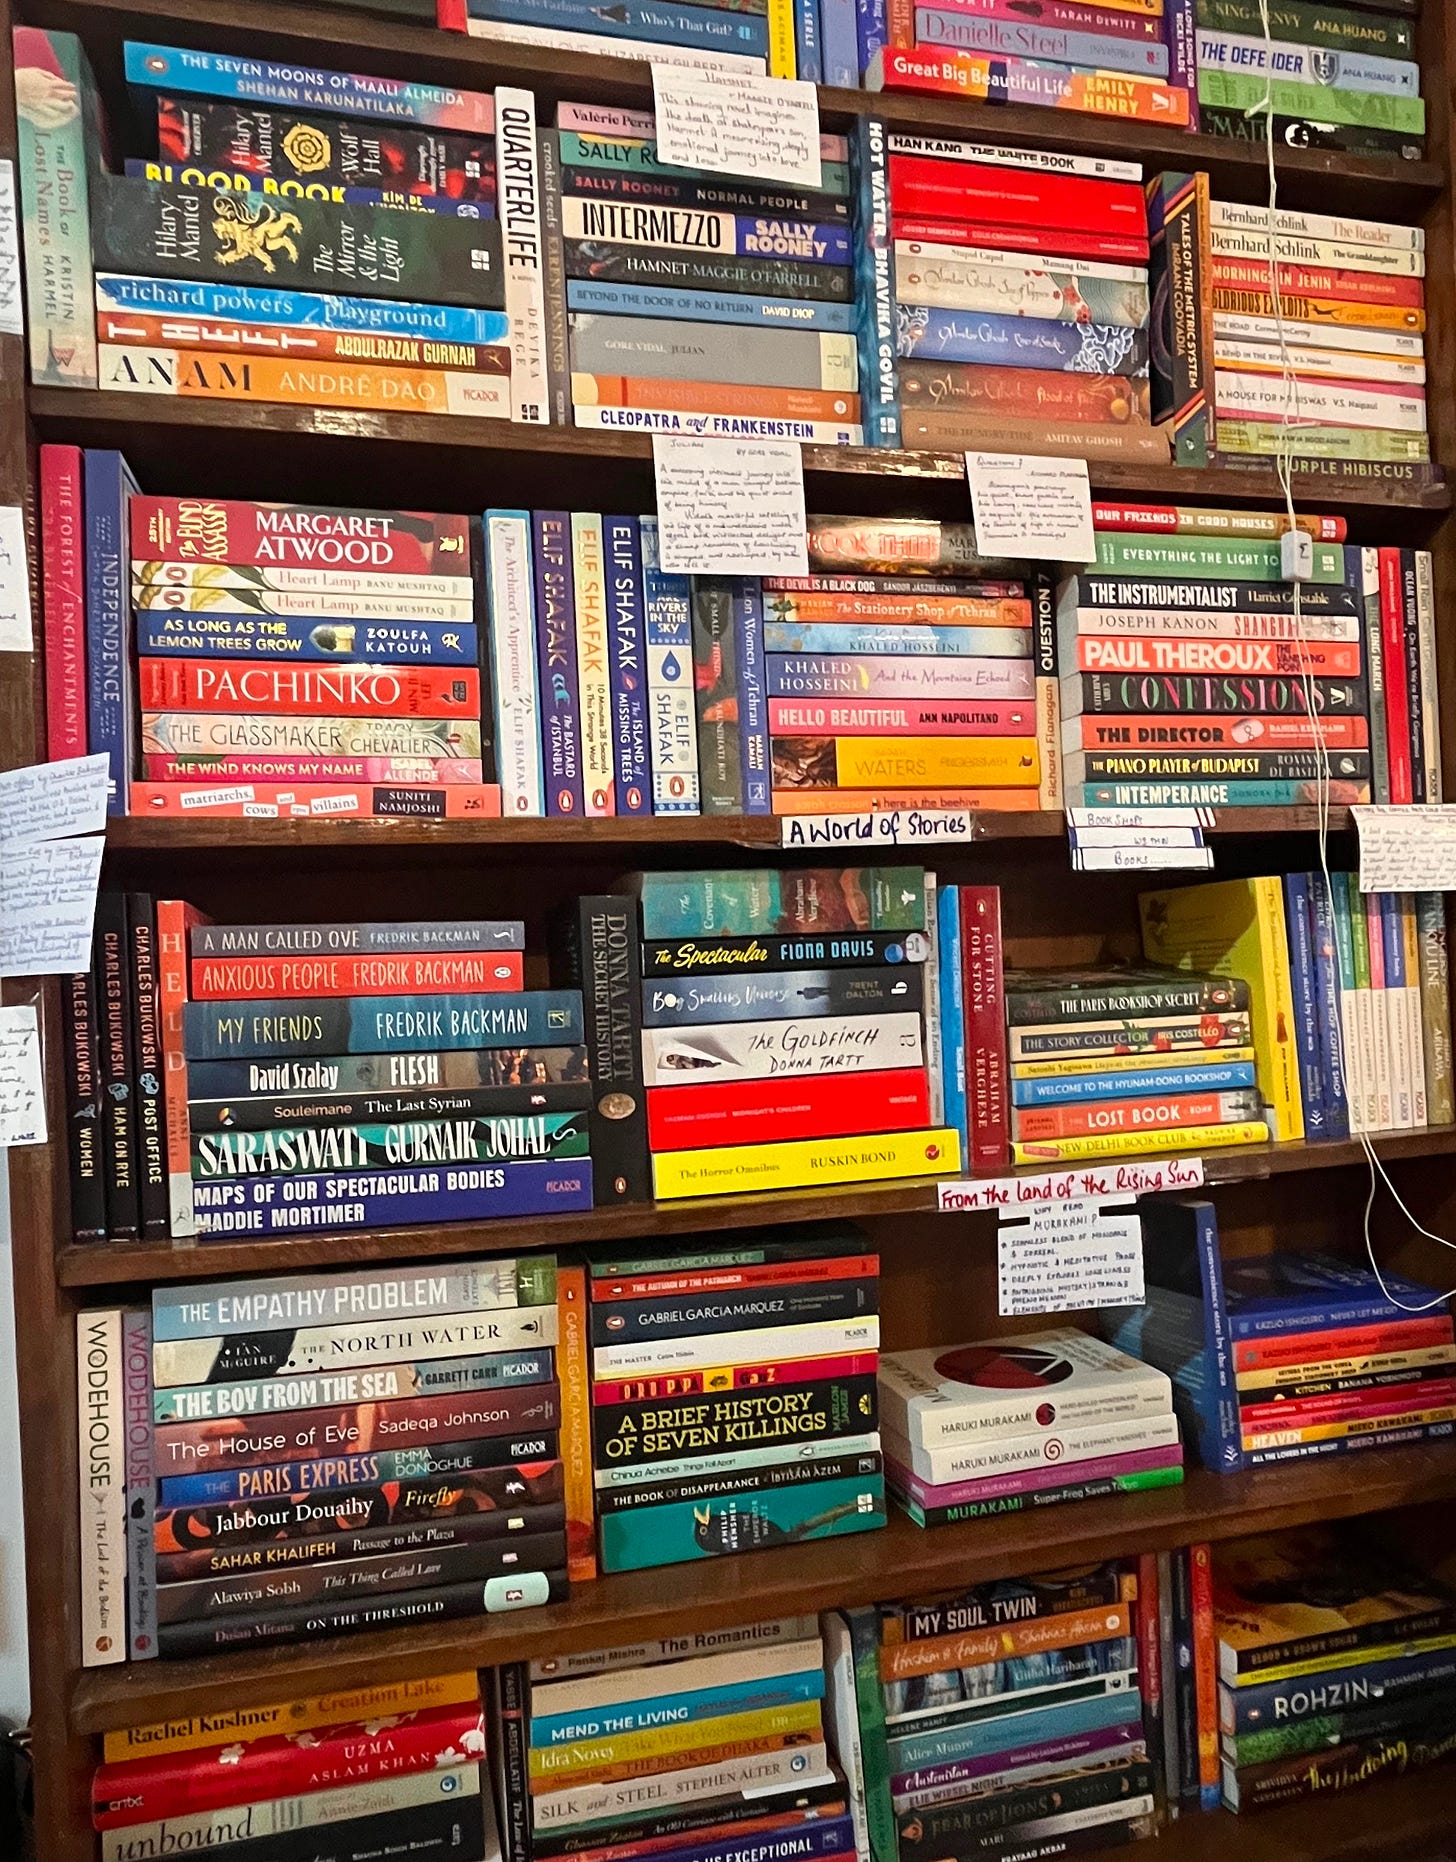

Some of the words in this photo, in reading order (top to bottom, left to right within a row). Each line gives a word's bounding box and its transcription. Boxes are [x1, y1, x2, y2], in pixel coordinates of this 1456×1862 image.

[640, 11, 674, 26] Who's
[677, 15, 703, 30] That
[707, 22, 733, 36] Girl?
[1314, 20, 1340, 36] ANA
[1343, 24, 1386, 42] HUANG
[181, 55, 209, 69] THE
[215, 59, 262, 76] SEVEN
[268, 66, 324, 84] MOONS
[329, 73, 349, 88] OF
[354, 77, 399, 95] MAALI
[404, 83, 465, 106] ALMEIDA
[893, 56, 939, 77] Great
[942, 63, 968, 84] Big
[971, 67, 1040, 93] Beautiful
[1044, 78, 1073, 96] Life
[1086, 78, 1135, 98] EMILY
[237, 80, 298, 100] SHEHAN
[304, 88, 415, 117] KARUNATILAKA
[1085, 94, 1139, 115] HENRY
[867, 122, 885, 163] HOT
[501, 107, 538, 269] QUARTERLIFE
[696, 189, 754, 205] NORMAL
[760, 196, 809, 211] PEOPLE
[869, 169, 889, 237] WATER
[581, 202, 722, 248] INTERMEZZO
[754, 220, 816, 241] SALLY
[1181, 213, 1191, 248] TALES
[746, 234, 827, 259] ROONEY
[1182, 250, 1192, 269] OF
[627, 258, 689, 276] HAMNET
[693, 263, 747, 283] MAGGIE
[751, 268, 820, 288] O'FARRELL
[1183, 269, 1193, 295] THE
[118, 282, 206, 306] richard
[213, 293, 294, 316] powers
[324, 304, 447, 330] playground
[577, 289, 618, 303] BEYOND
[621, 291, 642, 304] THE
[643, 294, 675, 307] DOOR
[678, 296, 693, 308] OF
[695, 298, 711, 310] NO
[714, 299, 754, 314] RETURN
[761, 305, 790, 317] DAVID
[791, 307, 815, 319] DIOP
[874, 248, 890, 339] BHAVIKA
[1185, 296, 1196, 340] METRIC
[334, 336, 419, 362] ABDULRAZAK
[424, 342, 476, 365] GURNAH
[1187, 341, 1198, 389] SYSTEM
[878, 344, 894, 403] GOVIL
[600, 409, 680, 429] CLEOPATRA
[686, 414, 708, 432] and
[713, 417, 814, 438] FRANKENSTEIN
[1046, 433, 1081, 445] AMITAV
[1085, 435, 1122, 448] GHOSH
[255, 511, 394, 538] MARGARET
[255, 537, 394, 565] ATWOOD
[611, 527, 632, 569] ELIF
[277, 570, 318, 587] Heart
[323, 573, 361, 591] Lamp
[367, 580, 393, 591] BANU
[396, 582, 446, 592] MUSHTAQ
[1090, 582, 1114, 604] THE
[1117, 583, 1238, 607] INSTRUMENTALIST
[367, 628, 429, 642] ZOULFA
[615, 577, 637, 670] SHAFAK
[1099, 614, 1155, 629] JOSEPH
[1161, 616, 1218, 630] KANON
[366, 642, 431, 655] KATOUH
[1085, 639, 1149, 667] PAUL
[1153, 641, 1273, 669] THEROUX
[196, 669, 400, 705] PACHINKO
[779, 708, 825, 725] HELLO
[830, 710, 909, 727] BEAUTIFUL
[169, 724, 201, 744] THE
[210, 725, 340, 747] GLASSMAKER
[790, 820, 806, 843] A
[810, 813, 872, 841] World
[880, 815, 899, 843] of
[908, 811, 966, 837] Stories
[655, 950, 671, 962] The
[674, 942, 768, 967] Spectacular
[781, 942, 824, 960] FIONA
[831, 940, 874, 958] DAVIS
[202, 965, 276, 992] ANXIOUS
[281, 963, 339, 990] PEOPLE
[353, 962, 410, 987] FREDRIK
[415, 960, 484, 985] BACKMAN
[749, 1033, 773, 1051] The
[249, 1065, 288, 1092] David
[293, 1064, 339, 1091] Szalay
[390, 1057, 439, 1086] FLESH
[274, 1103, 352, 1119] Souleimane
[365, 1100, 391, 1113] The
[396, 1100, 424, 1112] Last
[428, 1097, 471, 1111] Syrian
[198, 1128, 369, 1176] SARASWATI
[385, 1124, 479, 1163] GURNAIK
[486, 1117, 552, 1157] JOHAL
[810, 1154, 856, 1168] RUSKIN
[860, 1151, 896, 1163] BOND
[942, 1190, 980, 1209] From
[985, 1187, 1013, 1205] the
[1017, 1180, 1052, 1202] land
[1056, 1177, 1073, 1198] of
[1081, 1175, 1109, 1196] the
[1116, 1167, 1164, 1194] Rising
[1169, 1160, 1199, 1183] Sun
[194, 1211, 264, 1233] MADDIE
[270, 1204, 365, 1227] MORTIMER
[181, 1303, 210, 1323] THE
[218, 1289, 328, 1321] EMPATHY
[335, 1278, 447, 1312] PROBLEM
[88, 1321, 111, 1488] WODEHOUSE
[173, 1391, 213, 1418] THE
[218, 1386, 258, 1412] BOY
[262, 1380, 316, 1407] FROM
[321, 1376, 358, 1401] THE
[363, 1372, 398, 1397] SEA
[619, 1413, 636, 1433] A
[640, 1404, 708, 1430] BRIEF
[715, 1393, 814, 1421] HISTORY
[941, 1418, 979, 1433] HARUKI
[981, 1411, 1032, 1429] MURAKAMI
[168, 1441, 210, 1460] The
[220, 1432, 285, 1453] House
[296, 1428, 314, 1447] of
[325, 1425, 359, 1444] Eve
[379, 1416, 438, 1437] Sadeqa
[444, 1407, 509, 1425] Johnson
[605, 1437, 636, 1458] OF
[643, 1427, 719, 1453] SEVEN
[725, 1412, 827, 1443] KILLINGS
[216, 1509, 287, 1535] Jabbour
[296, 1498, 373, 1527] Douaihy
[405, 1488, 456, 1507] Firefly
[947, 1498, 1023, 1521] MURAKAMI
[915, 1616, 942, 1635] MY
[947, 1605, 989, 1630] SOUL
[994, 1597, 1037, 1620] TWIN
[658, 1638, 688, 1655] The
[695, 1623, 781, 1647] Romantics
[1275, 1678, 1369, 1717] ROHZIN
[552, 1723, 599, 1740] MEND
[603, 1715, 633, 1729] THE
[639, 1707, 688, 1725] LIVING
[344, 1740, 395, 1760] UZMA
[308, 1765, 370, 1784] ASLAM
[380, 1752, 430, 1770] KHAN
